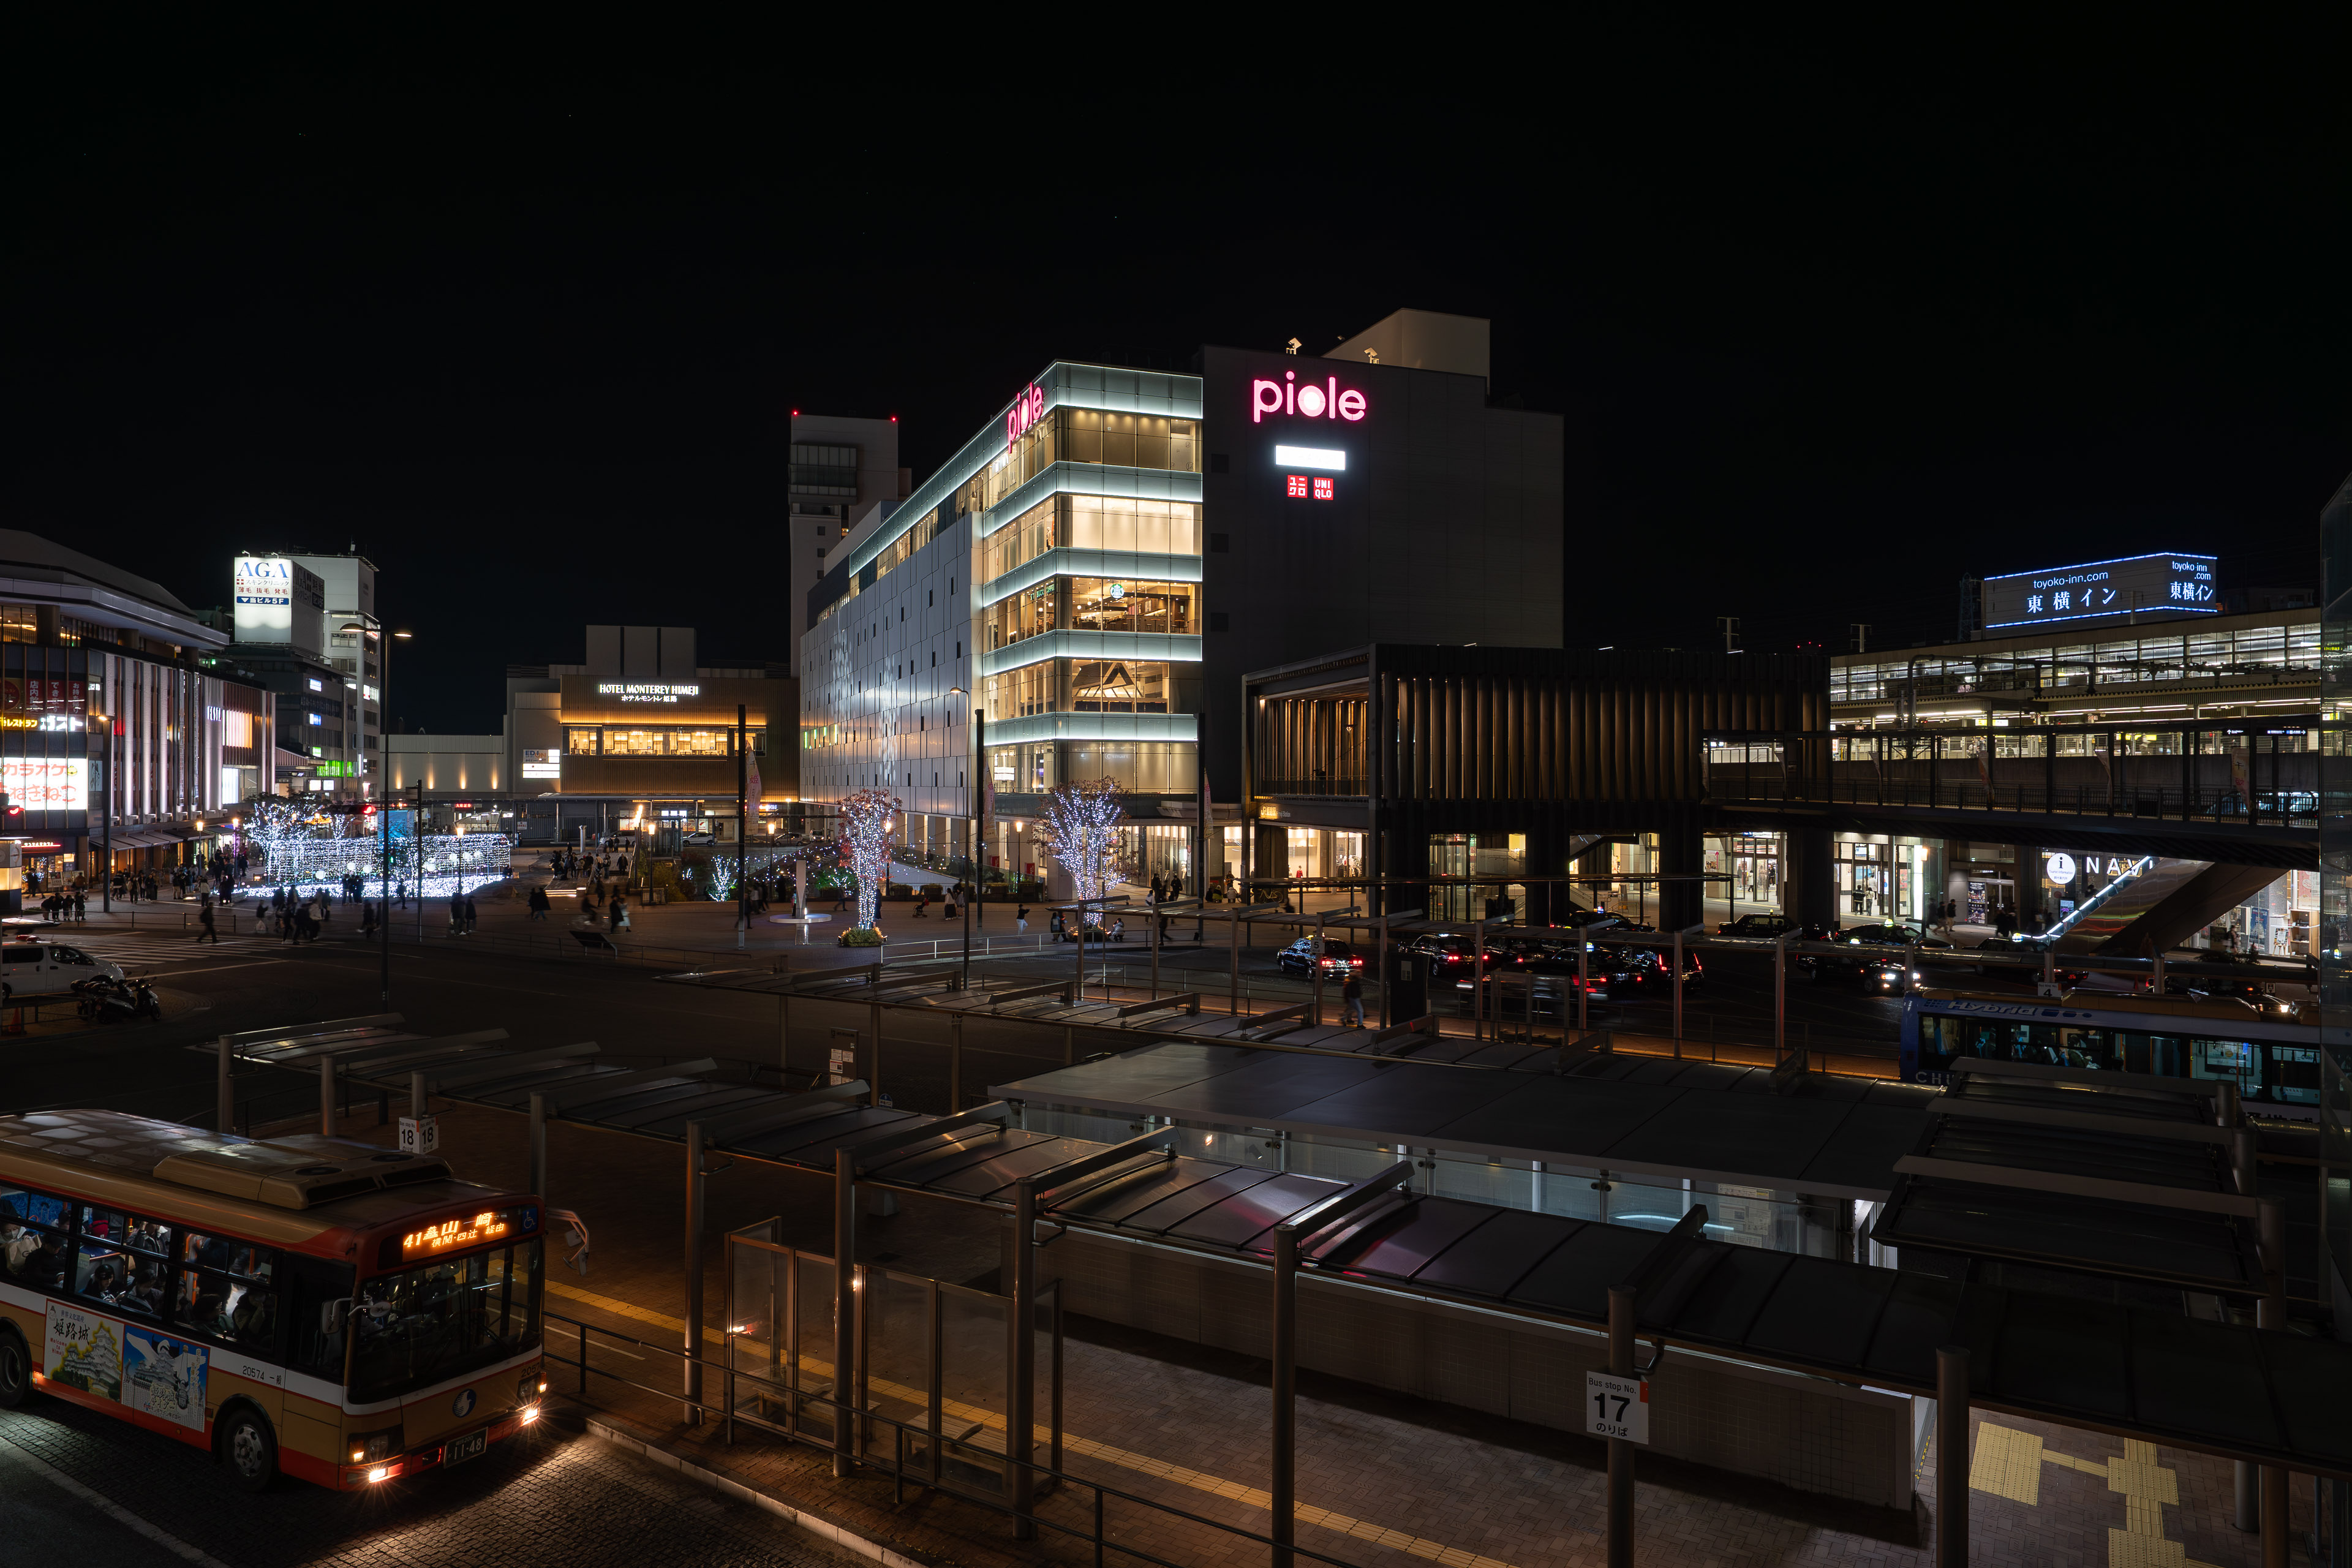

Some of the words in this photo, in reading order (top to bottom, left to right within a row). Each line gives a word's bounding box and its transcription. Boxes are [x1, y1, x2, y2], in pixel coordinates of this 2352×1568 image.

[1253, 371, 1366, 423] piole
[1008, 382, 1043, 454] piole
[1314, 479, 1330, 489] UNI
[1314, 489, 1332, 499] QLO
[236, 562, 289, 578] AGA
[2034, 571, 2108, 590] toyoko-inn.com
[2170, 581, 2213, 602] 東横イン
[2027, 588, 2116, 613] 東横イン
[599, 684, 625, 693] HOTEL
[626, 685, 669, 694] MONTEREY
[671, 685, 699, 696] HIMEJI
[3, 763, 67, 776] カラオケ
[1947, 1001, 2040, 1016] Hybrid
[401, 1129, 413, 1145] 18
[422, 1126, 434, 1145] 18
[485, 1223, 505, 1235] 経由
[404, 1232, 422, 1248] 41
[53, 1318, 90, 1346] 姫路城
[50, 1337, 67, 1347] Welcome
[243, 1365, 265, 1381] 20574
[1589, 1377, 1602, 1387] Bus
[1605, 1381, 1621, 1392] stop
[1624, 1384, 1637, 1394] No.
[1594, 1392, 1630, 1423] 17
[1596, 1422, 1629, 1437] のりば
